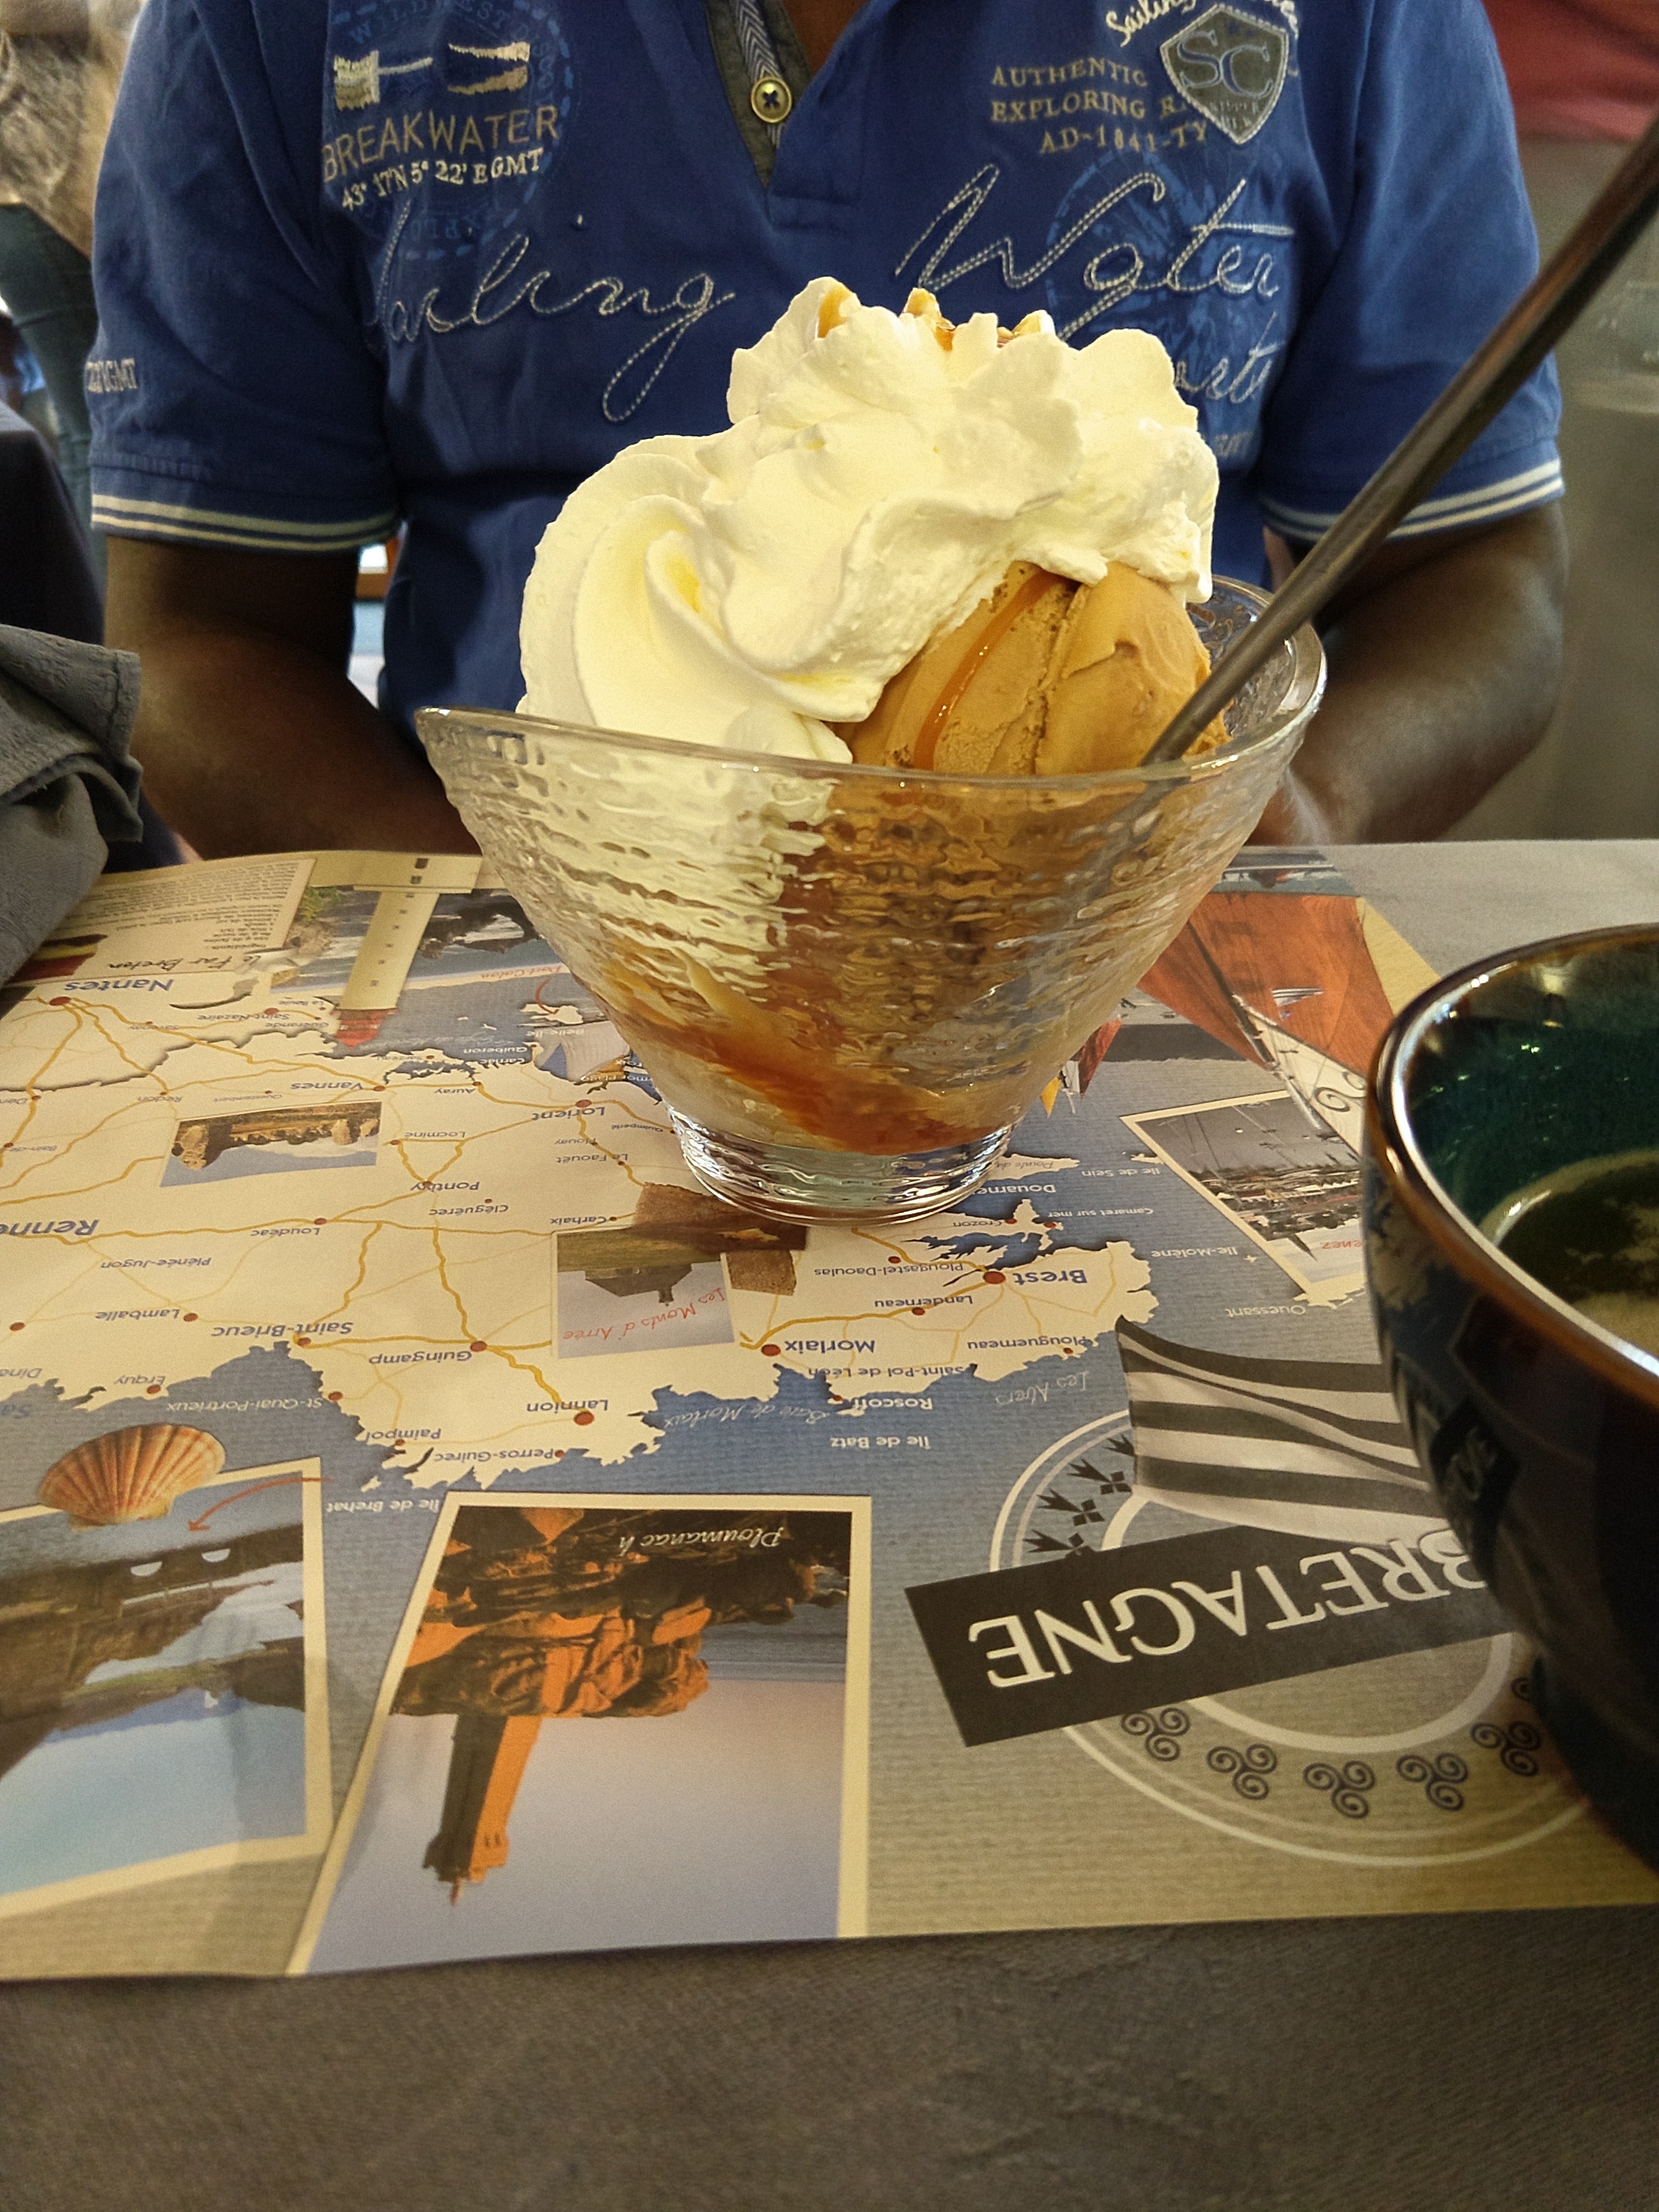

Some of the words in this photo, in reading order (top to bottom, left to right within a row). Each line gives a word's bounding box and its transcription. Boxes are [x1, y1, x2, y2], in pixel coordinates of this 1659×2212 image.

[992, 57, 1148, 87] AUTHENTIC
[991, 89, 1146, 122] EXPLORING
[322, 105, 559, 182] BREAKWATER
[107, 957, 184, 973] Breton
[65, 978, 174, 994] Nantes
[197, 1013, 291, 1022] Saint-Nazaire
[264, 1022, 329, 1030] Guérande
[462, 1046, 528, 1055] Quiberon
[290, 1081, 364, 1091] Vannes
[433, 1086, 476, 1096] Auray
[531, 1106, 605, 1121] Lorient
[611, 1123, 664, 1133] Quimperlé
[403, 1130, 466, 1140] Locminé
[555, 1154, 607, 1164] Faouët
[1081, 1170, 1114, 1178] Sein
[1119, 1169, 1137, 1177] de
[973, 1183, 1057, 1196] Douarne
[428, 1204, 508, 1217] Cléguérec
[1047, 1210, 1073, 1218] mer
[1099, 1207, 1154, 1216] Camaret
[0, 1218, 100, 1236] Renne
[550, 1215, 607, 1226] Carhaix
[250, 1227, 320, 1238] Loudéac
[1150, 1246, 1238, 1259] Ile-Molène
[100, 1257, 212, 1269] Plénée-Jugon
[814, 1262, 963, 1277] Plougastel-Daoulas
[1014, 1269, 1087, 1286] Brest
[874, 1294, 973, 1309] Landerneau
[95, 1308, 180, 1321] Lamballe
[640, 1302, 697, 1330] Monts
[1224, 1305, 1306, 1318] Ouessant
[211, 1321, 354, 1339] Saint-Brieuc
[784, 1339, 874, 1354] Morlaix
[967, 1335, 1088, 1352] Plouguerneau
[368, 1349, 472, 1367] Guingamp
[0, 1368, 42, 1379] Dina
[809, 1367, 851, 1379] Léon
[857, 1367, 881, 1377] de
[888, 1365, 965, 1378] Saint-Pol
[114, 1374, 166, 1387] Erquy
[165, 1397, 323, 1413] St-Quai-Portrieux
[526, 1399, 609, 1414] Lannion
[851, 1397, 933, 1410] Roscoff
[365, 1427, 442, 1442] Paimpol
[830, 1436, 869, 1449] Batz
[876, 1436, 901, 1447] de
[433, 1448, 554, 1464] Perros-Guirec
[390, 1500, 414, 1512] de
[967, 1528, 1488, 1689] BRETAGNE
